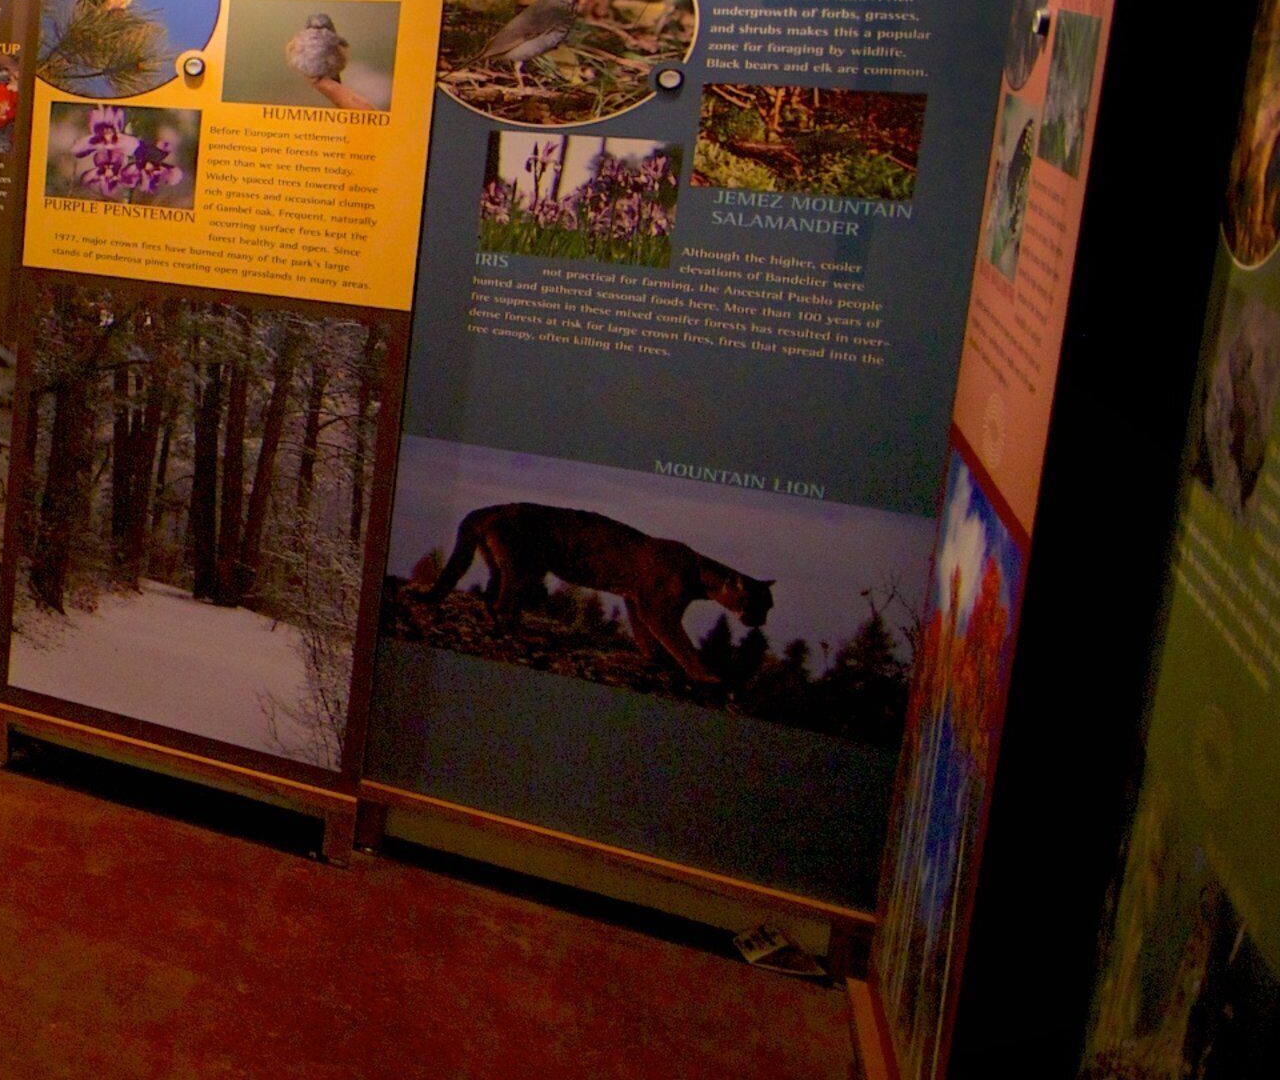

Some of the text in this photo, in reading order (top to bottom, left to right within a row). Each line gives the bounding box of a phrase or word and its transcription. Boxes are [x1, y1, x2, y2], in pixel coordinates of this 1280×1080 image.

[262, 107, 391, 127] HUMMINGBIRD
[44, 198, 196, 223] PURPLE PENSTEMON
[713, 189, 913, 219] JEMEZ MOUNTAIN
[711, 211, 859, 237] SALAMANDER
[475, 252, 509, 268] IRIS
[654, 459, 825, 499] MOUNTAIN LION
